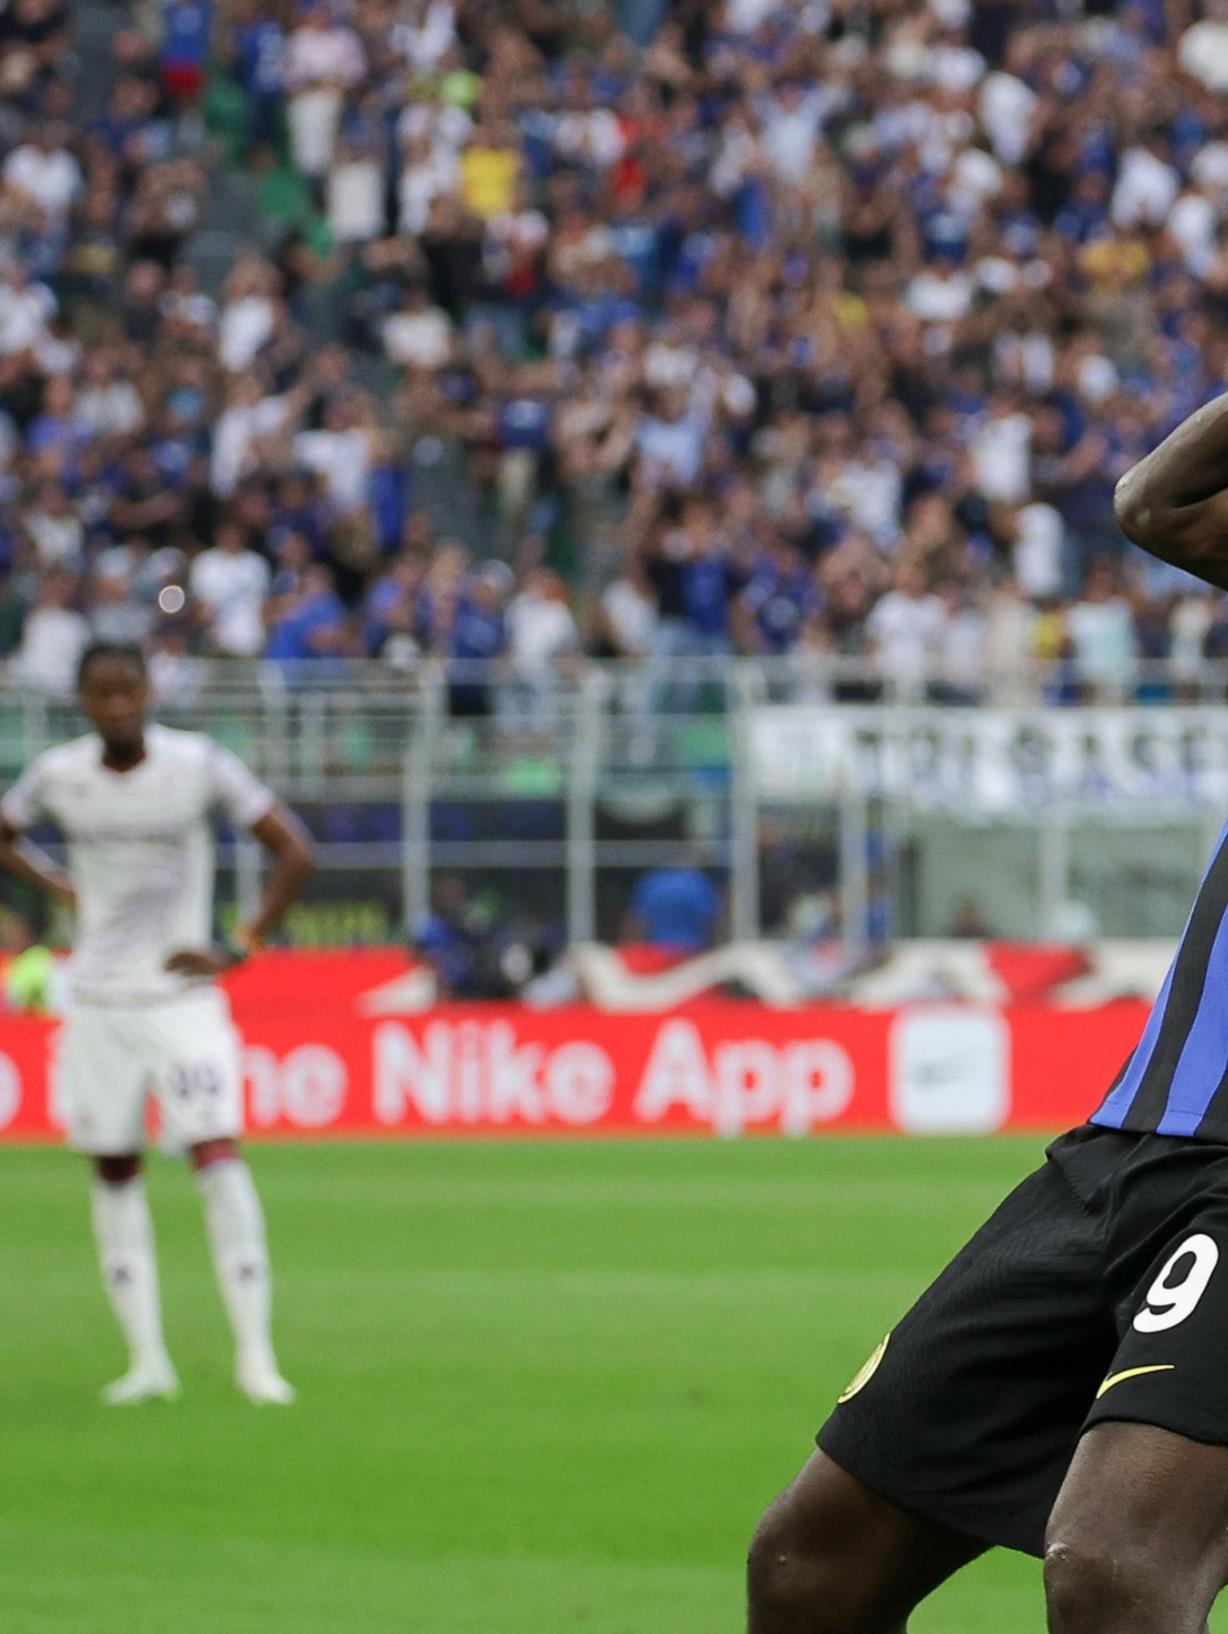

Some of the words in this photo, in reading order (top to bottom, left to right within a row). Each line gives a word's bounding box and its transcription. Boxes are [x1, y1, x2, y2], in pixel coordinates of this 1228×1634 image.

[372, 1018, 615, 1127] Nike
[631, 1018, 856, 1140] App
[1132, 1233, 1219, 1333] 9
